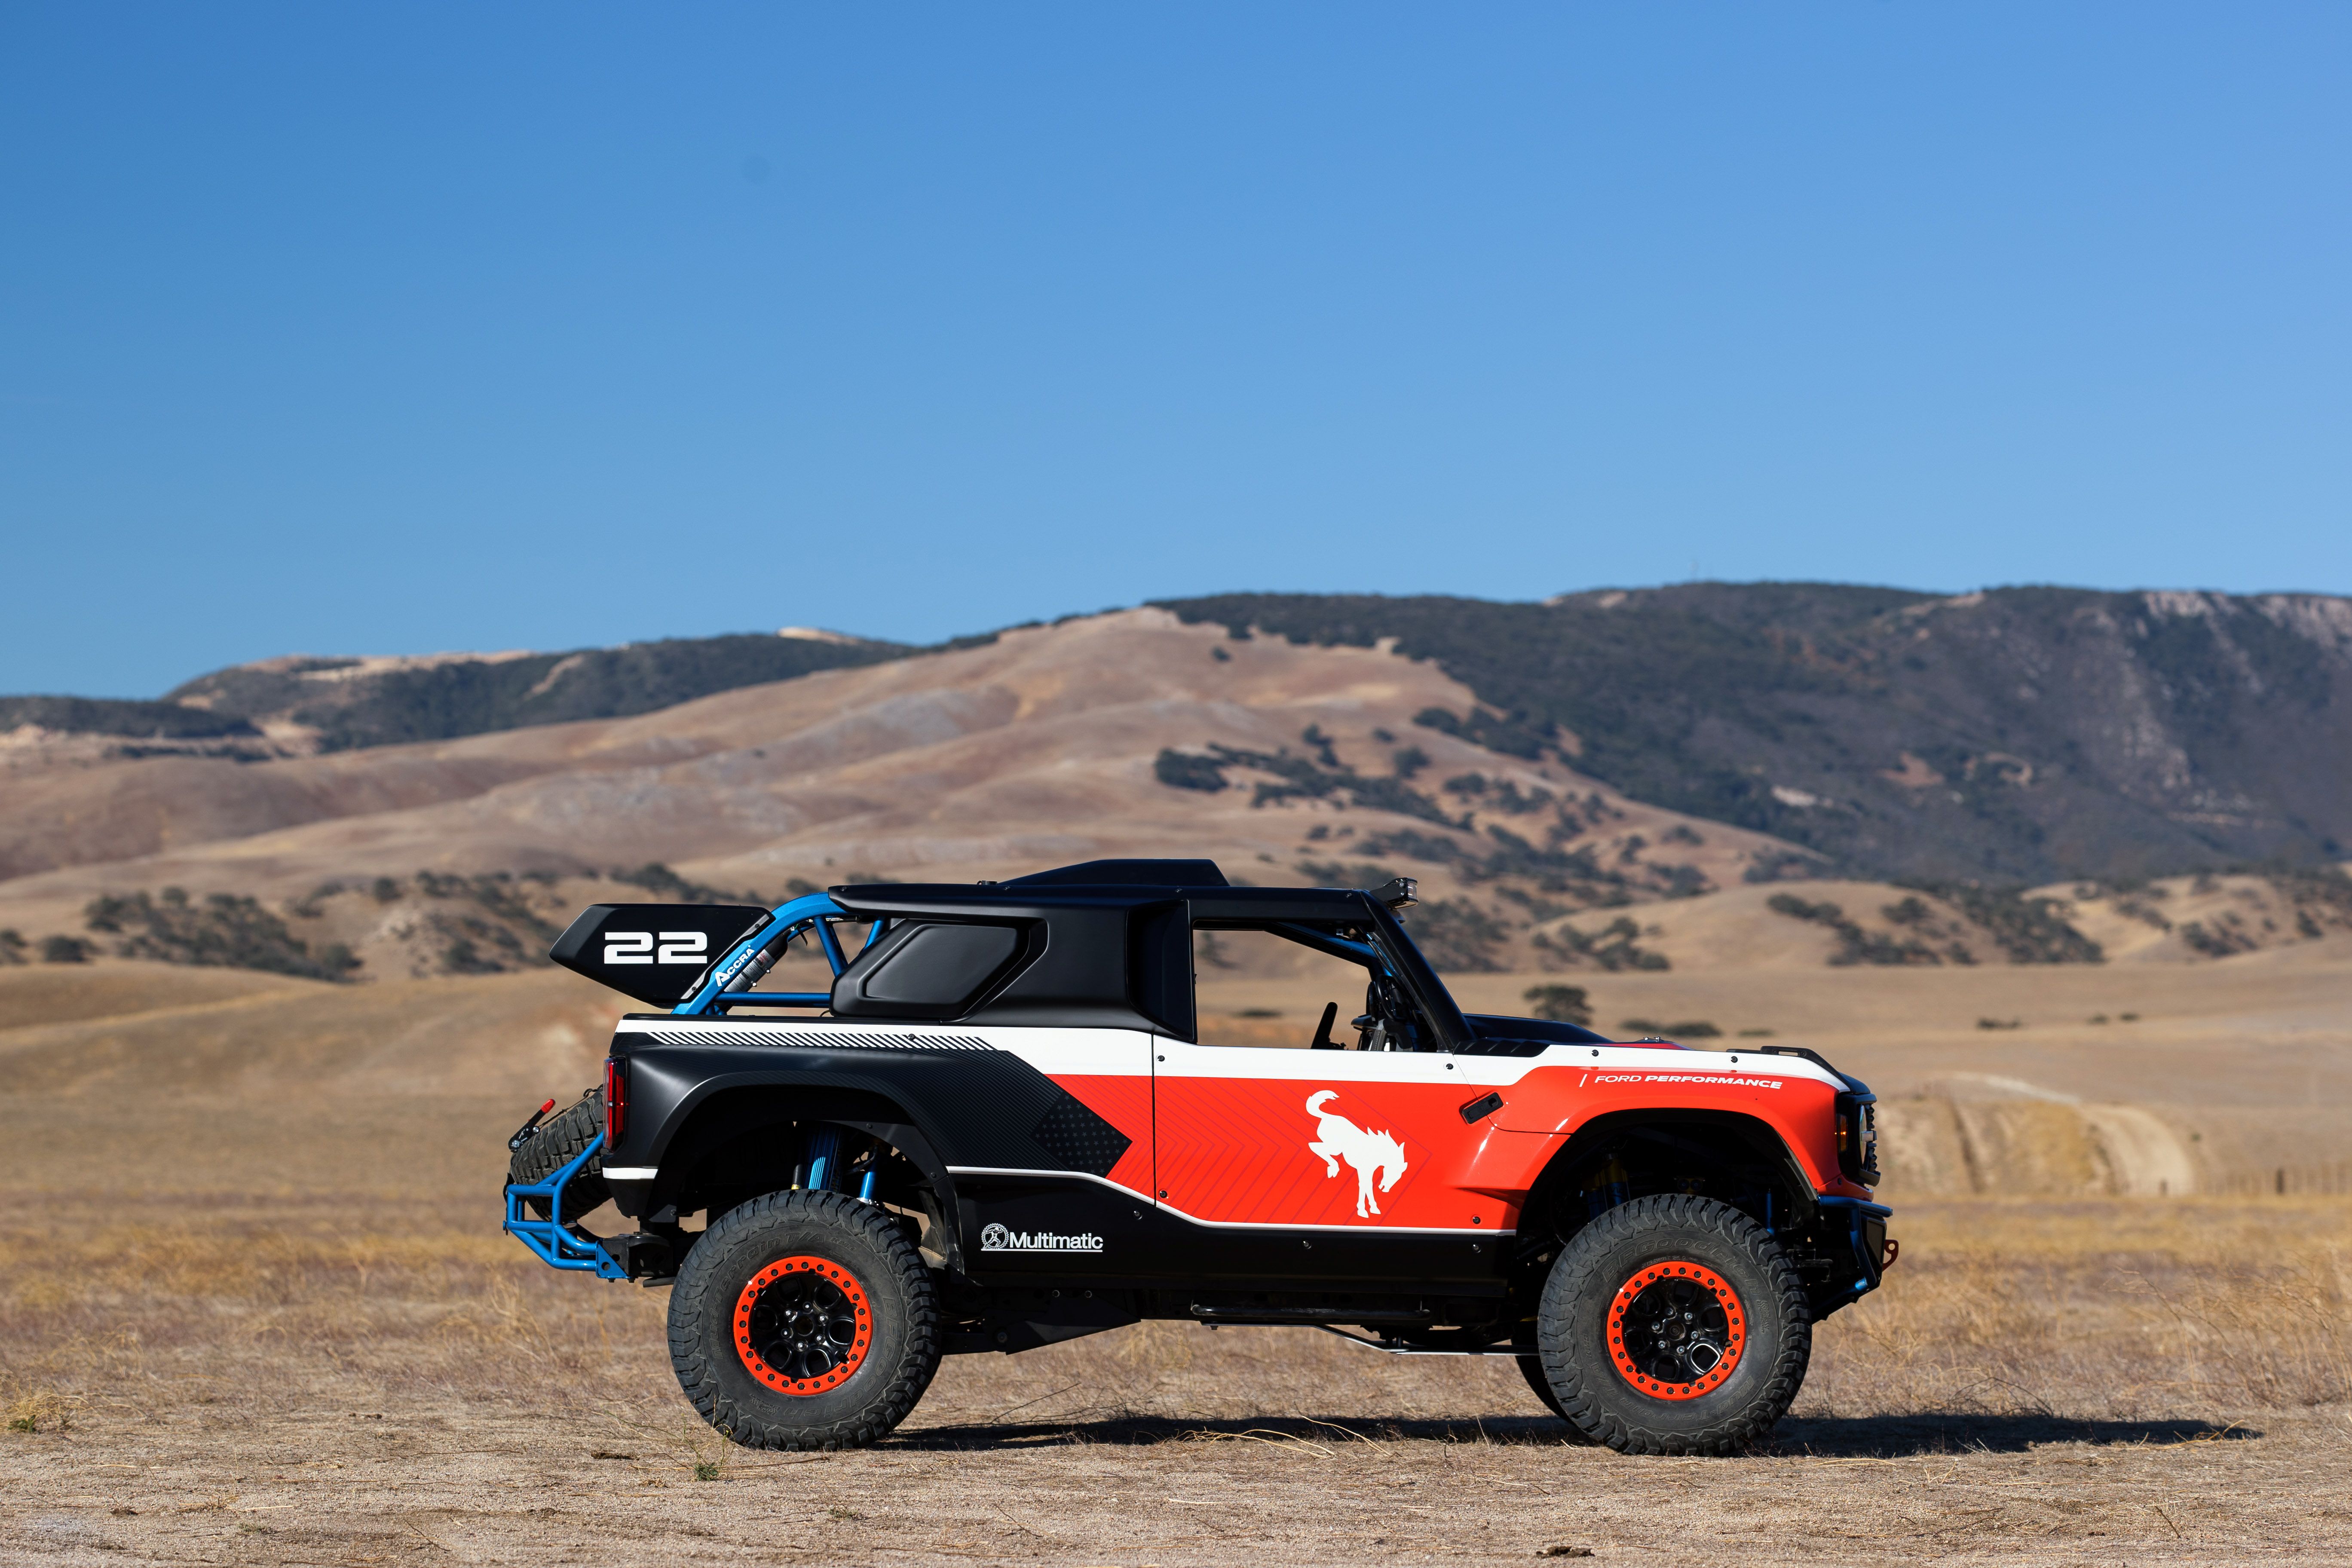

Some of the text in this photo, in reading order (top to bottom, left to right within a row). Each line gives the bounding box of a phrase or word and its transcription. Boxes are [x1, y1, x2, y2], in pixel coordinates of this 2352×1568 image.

[604, 932, 707, 964] 22
[716, 948, 755, 987] ACCRA
[1645, 1075, 1783, 1089] PERFORMANCE
[1010, 1232, 1103, 1249] Multimatic
[1602, 1237, 1761, 1295] BFGoodrich
[710, 1238, 780, 1360] Mud-Terrain
[786, 1231, 825, 1243] T/A
[784, 1297, 899, 1419] BFGoodrich
